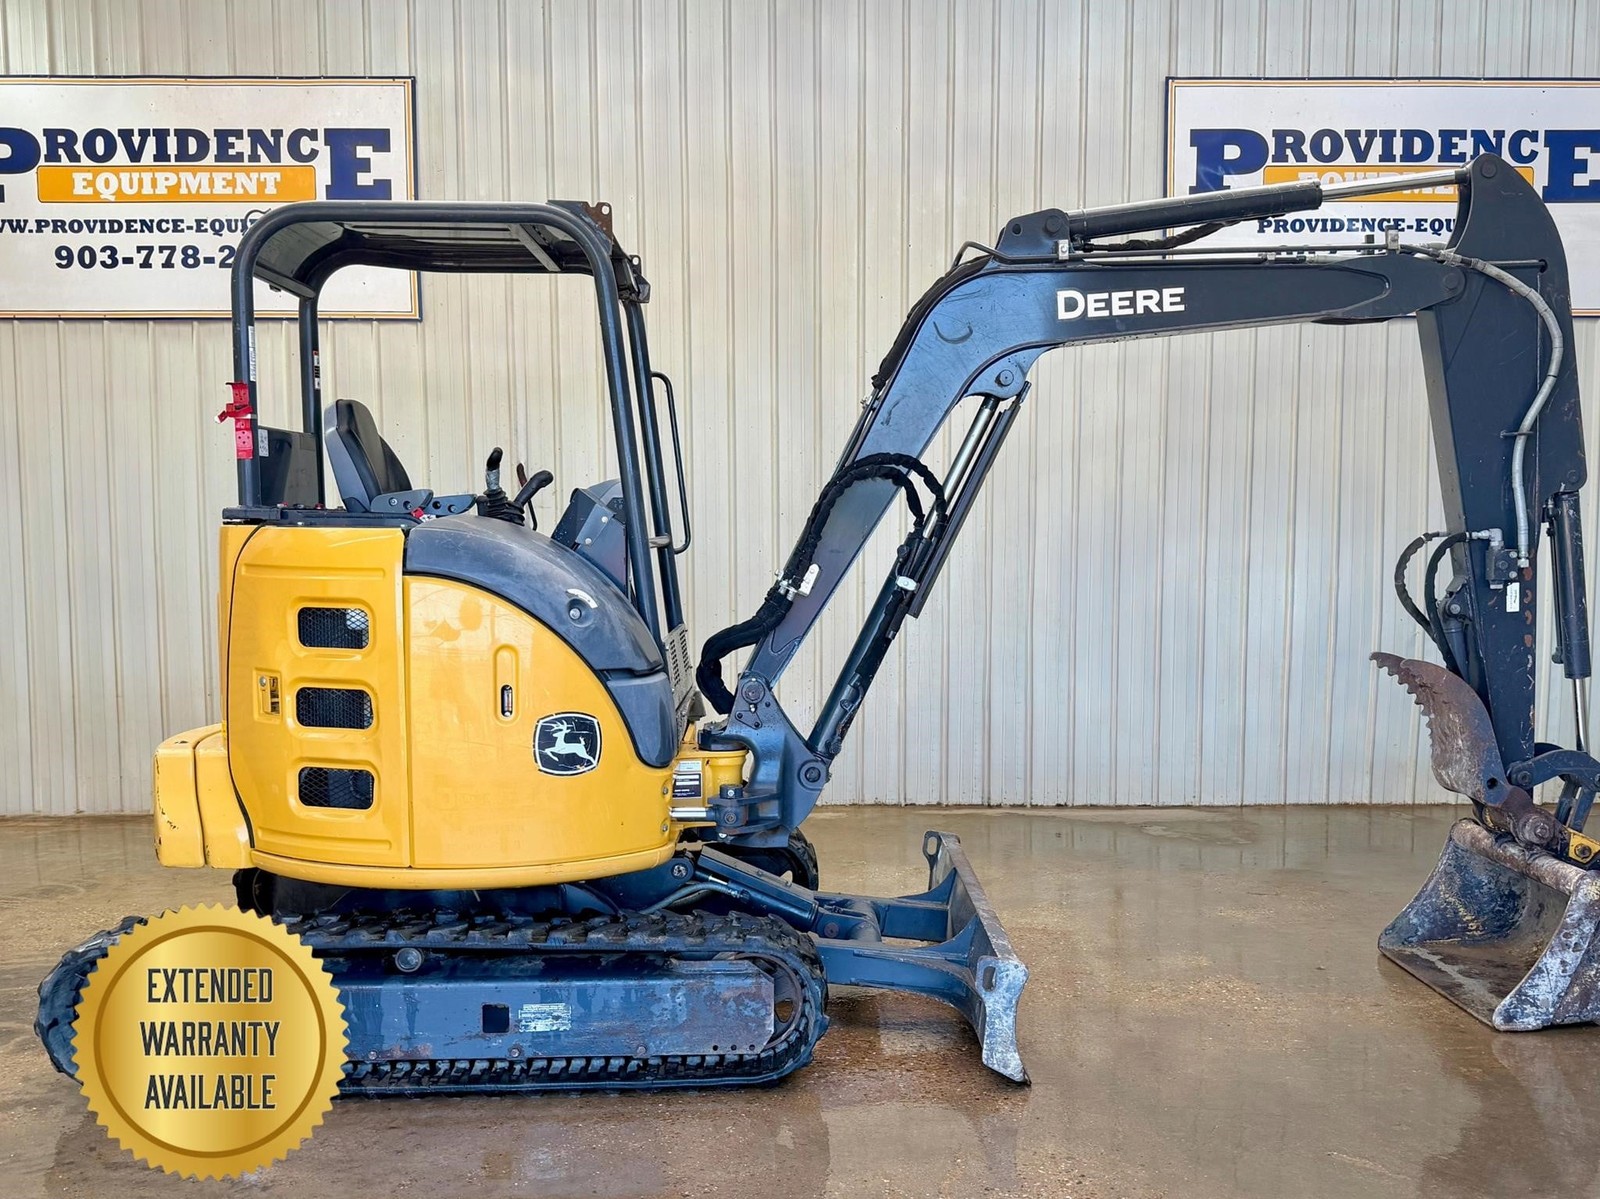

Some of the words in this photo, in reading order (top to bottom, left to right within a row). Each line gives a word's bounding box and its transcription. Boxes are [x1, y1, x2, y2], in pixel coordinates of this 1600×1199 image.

[1189, 128, 1600, 204] PROVIDENCE
[72, 172, 281, 202] EQUIPMENT
[0, 219, 258, 237] W.PROVIDENCE-EQUI
[54, 245, 236, 269] 903-778-2
[1056, 287, 1185, 320] DEERE
